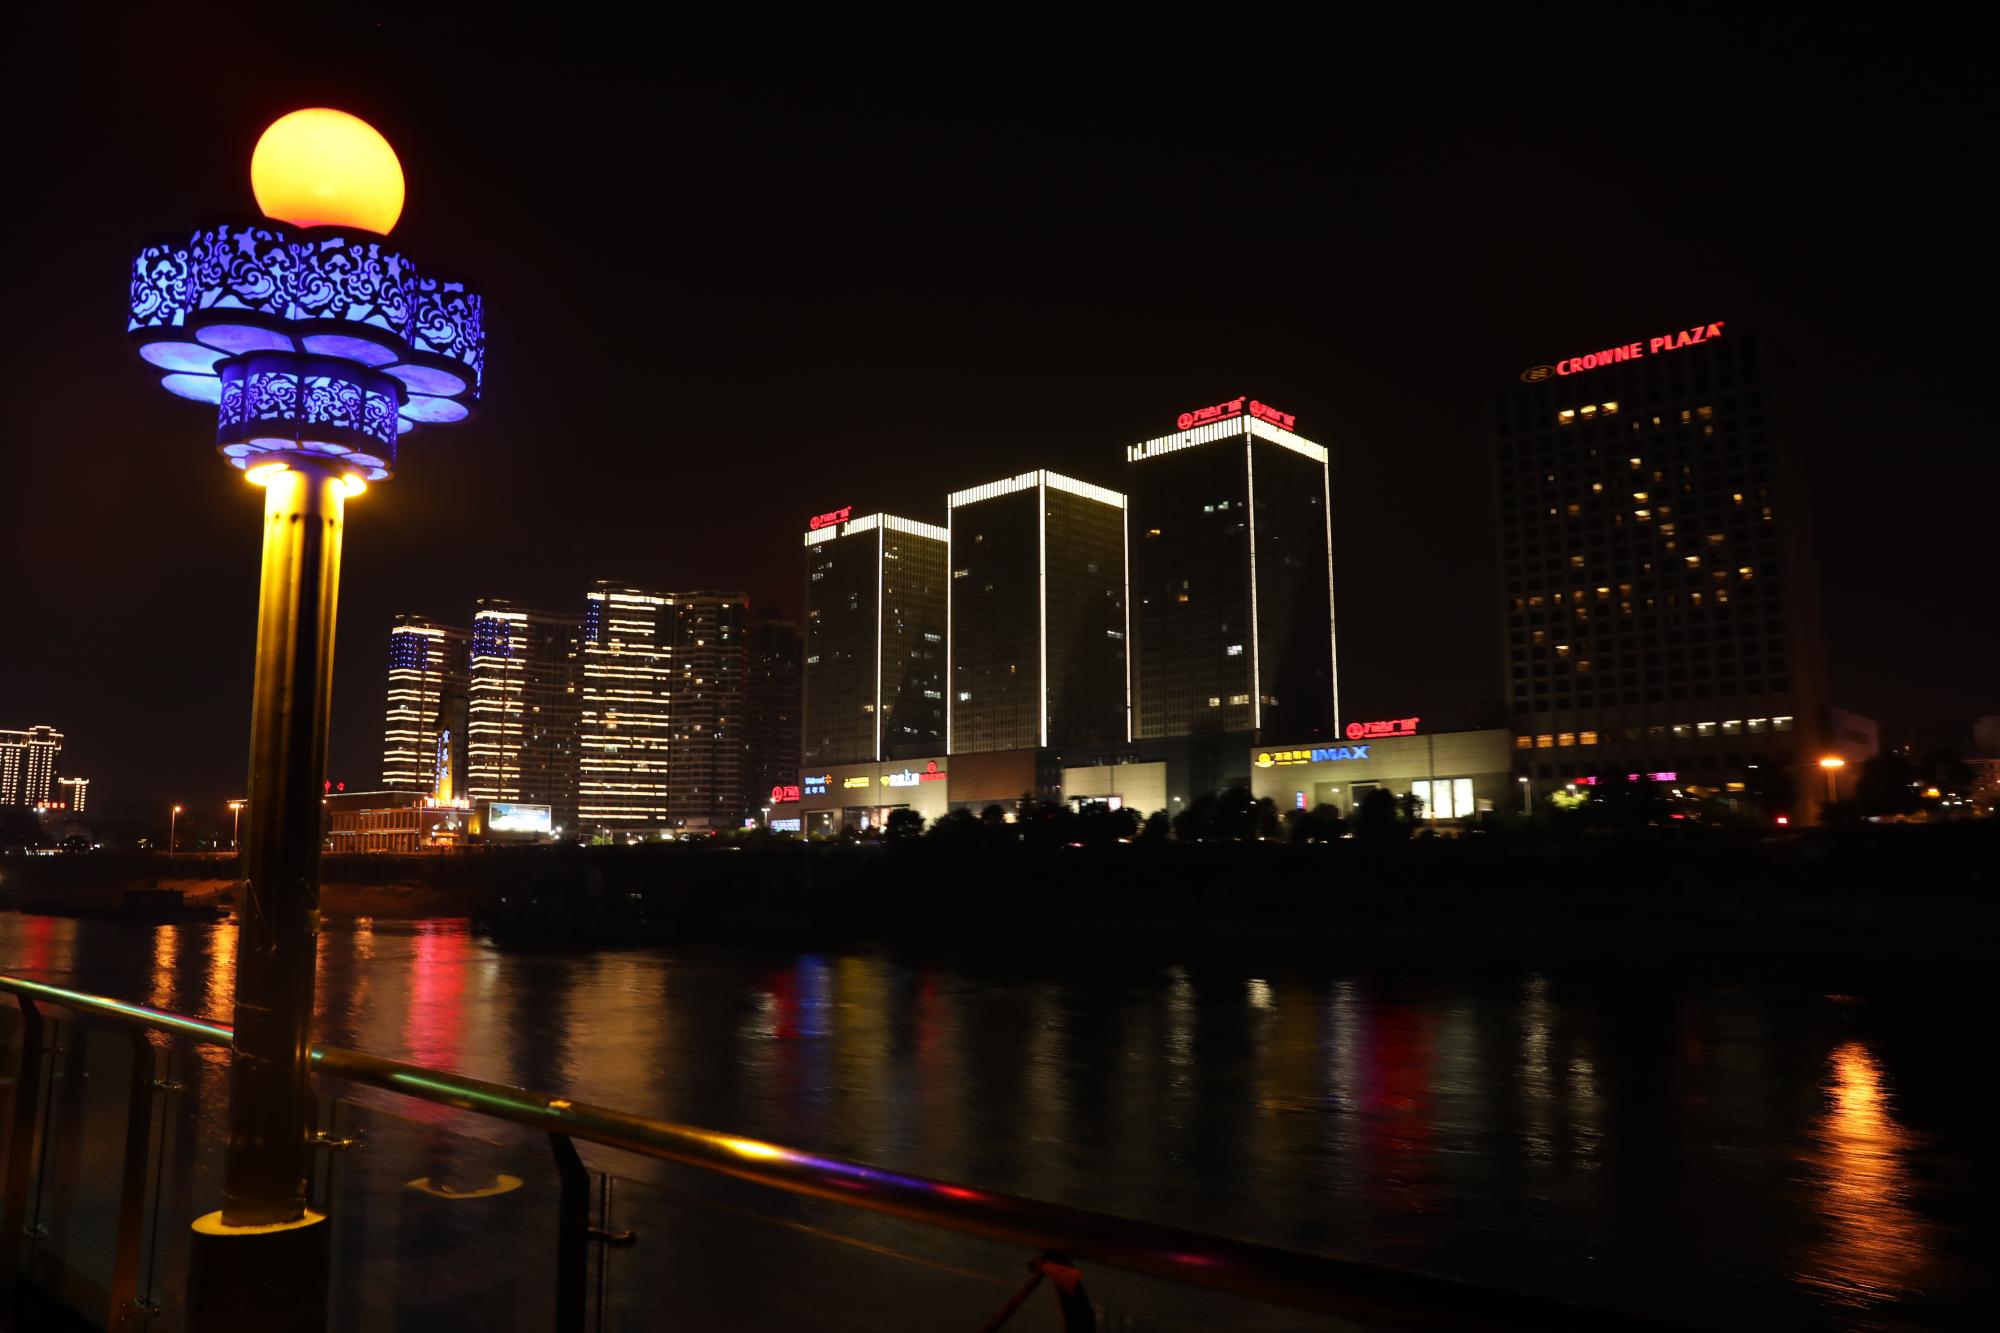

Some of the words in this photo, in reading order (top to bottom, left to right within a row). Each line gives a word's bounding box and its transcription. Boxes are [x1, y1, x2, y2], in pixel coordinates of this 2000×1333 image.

[1556, 342, 1643, 375] CROWNE
[1651, 322, 1722, 353] PLAZA
[1312, 746, 1369, 761] IMAX
